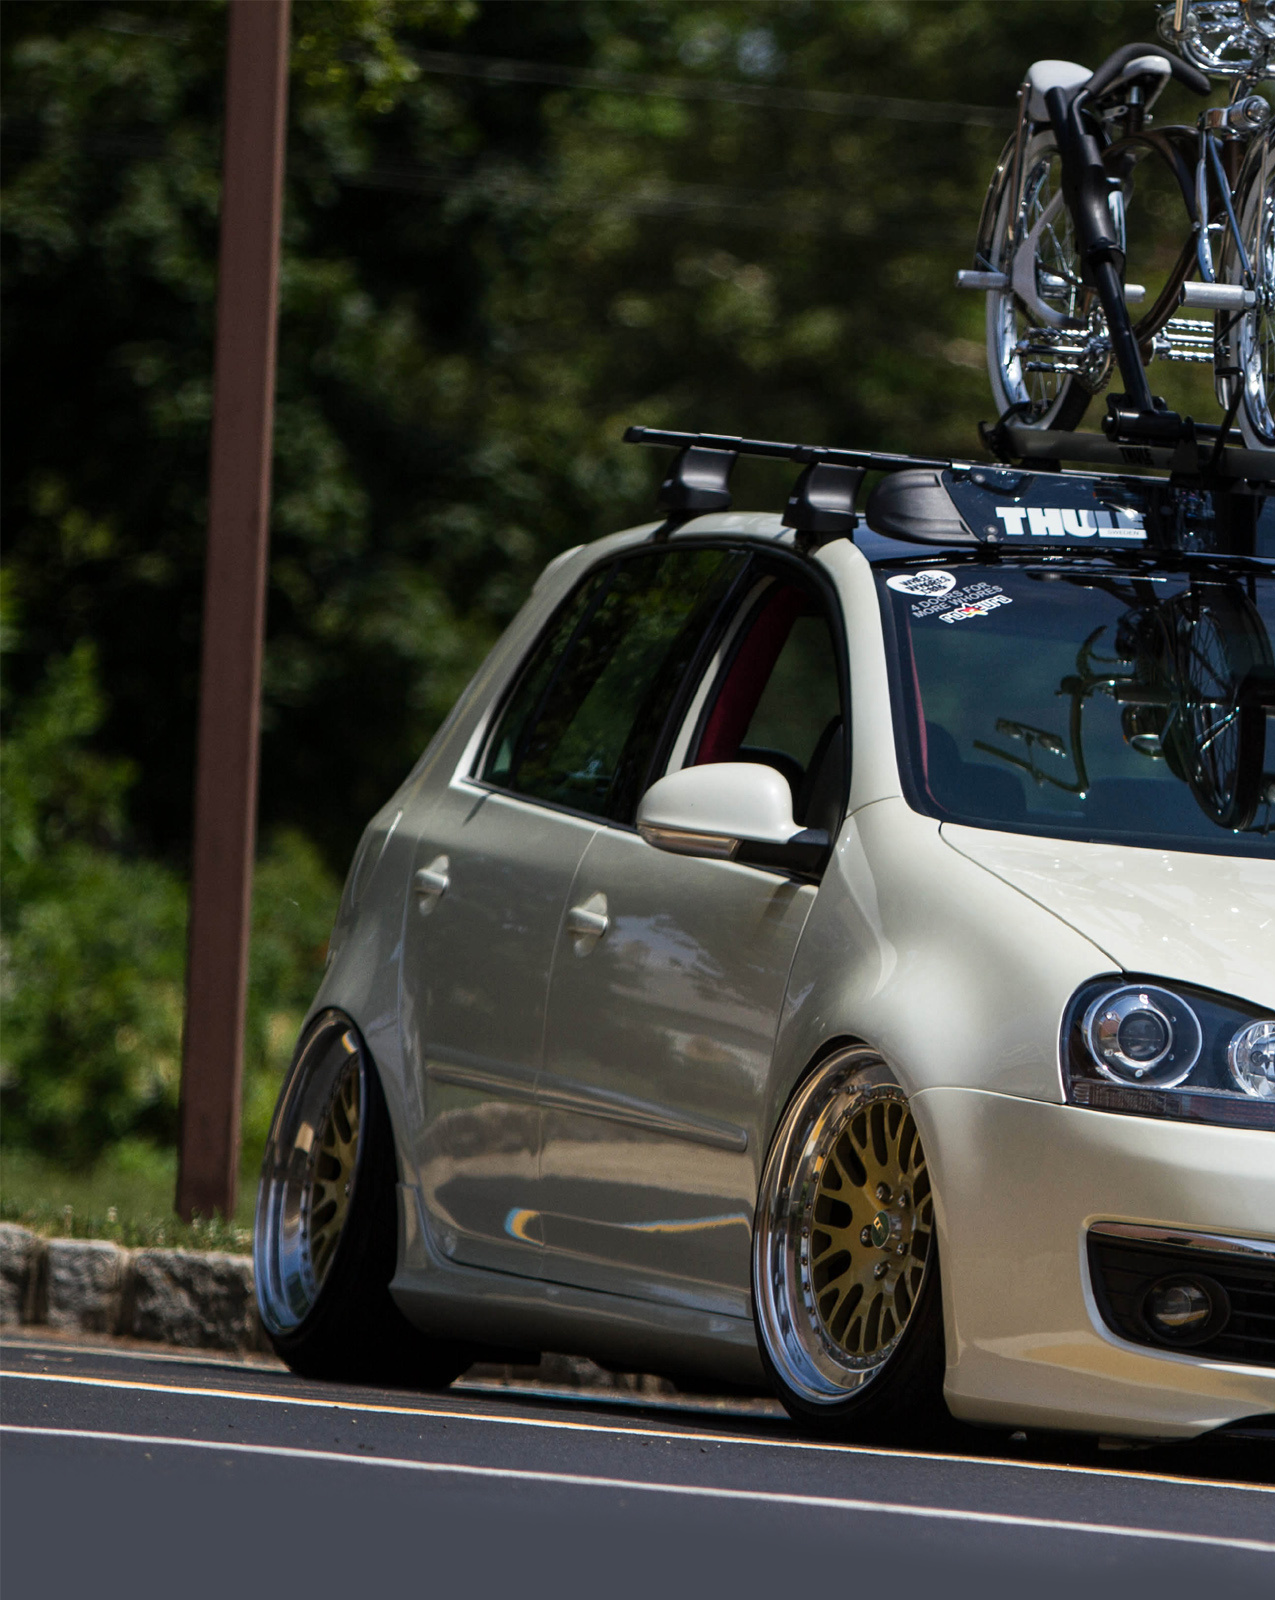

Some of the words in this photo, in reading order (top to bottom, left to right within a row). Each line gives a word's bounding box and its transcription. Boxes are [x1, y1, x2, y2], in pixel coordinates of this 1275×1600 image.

[995, 507, 1148, 540] THULE
[911, 604, 920, 612] 4
[919, 589, 964, 608] DOORS
[962, 582, 991, 594] FOR
[912, 602, 951, 618] MORE
[948, 585, 1003, 606] WHORES
